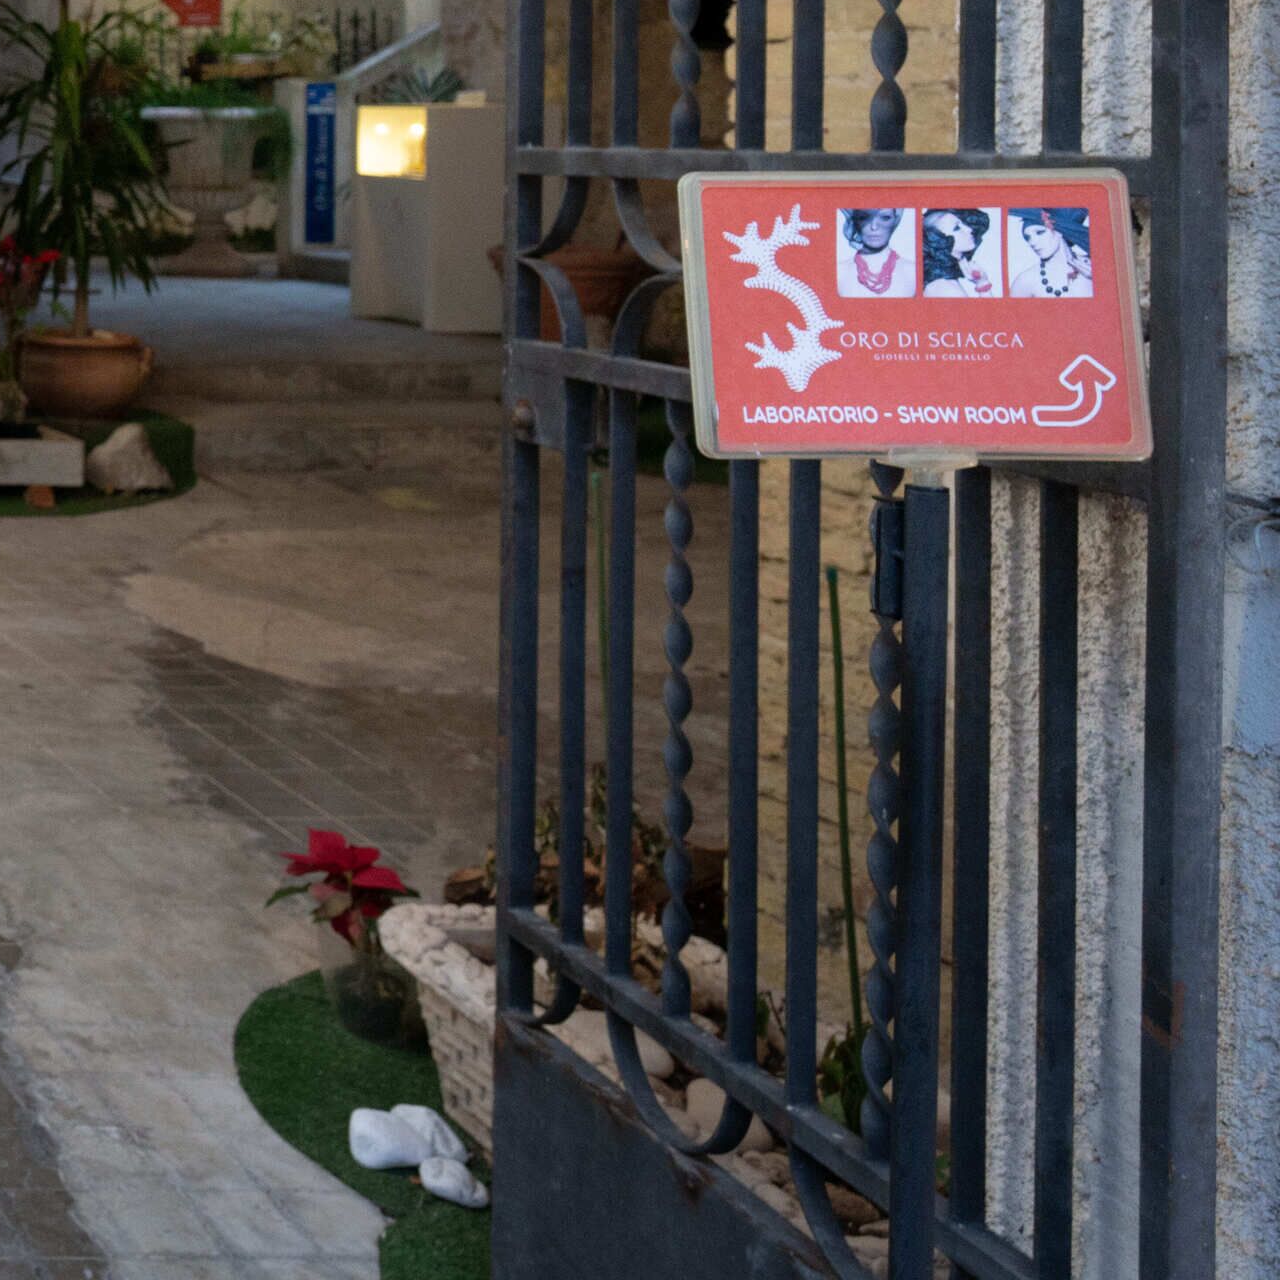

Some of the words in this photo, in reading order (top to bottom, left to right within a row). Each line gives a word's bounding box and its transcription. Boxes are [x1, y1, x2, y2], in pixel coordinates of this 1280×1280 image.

[840, 331, 889, 350] ORO
[898, 332, 919, 348] DI
[928, 332, 1025, 348] SCIACCA
[873, 353, 920, 361] GIOIELLI
[925, 353, 936, 361] IN
[942, 353, 991, 361] CORALLO
[742, 406, 879, 424] LABORATORIO
[897, 406, 959, 424] SHOW
[966, 406, 1027, 424] ROOM
